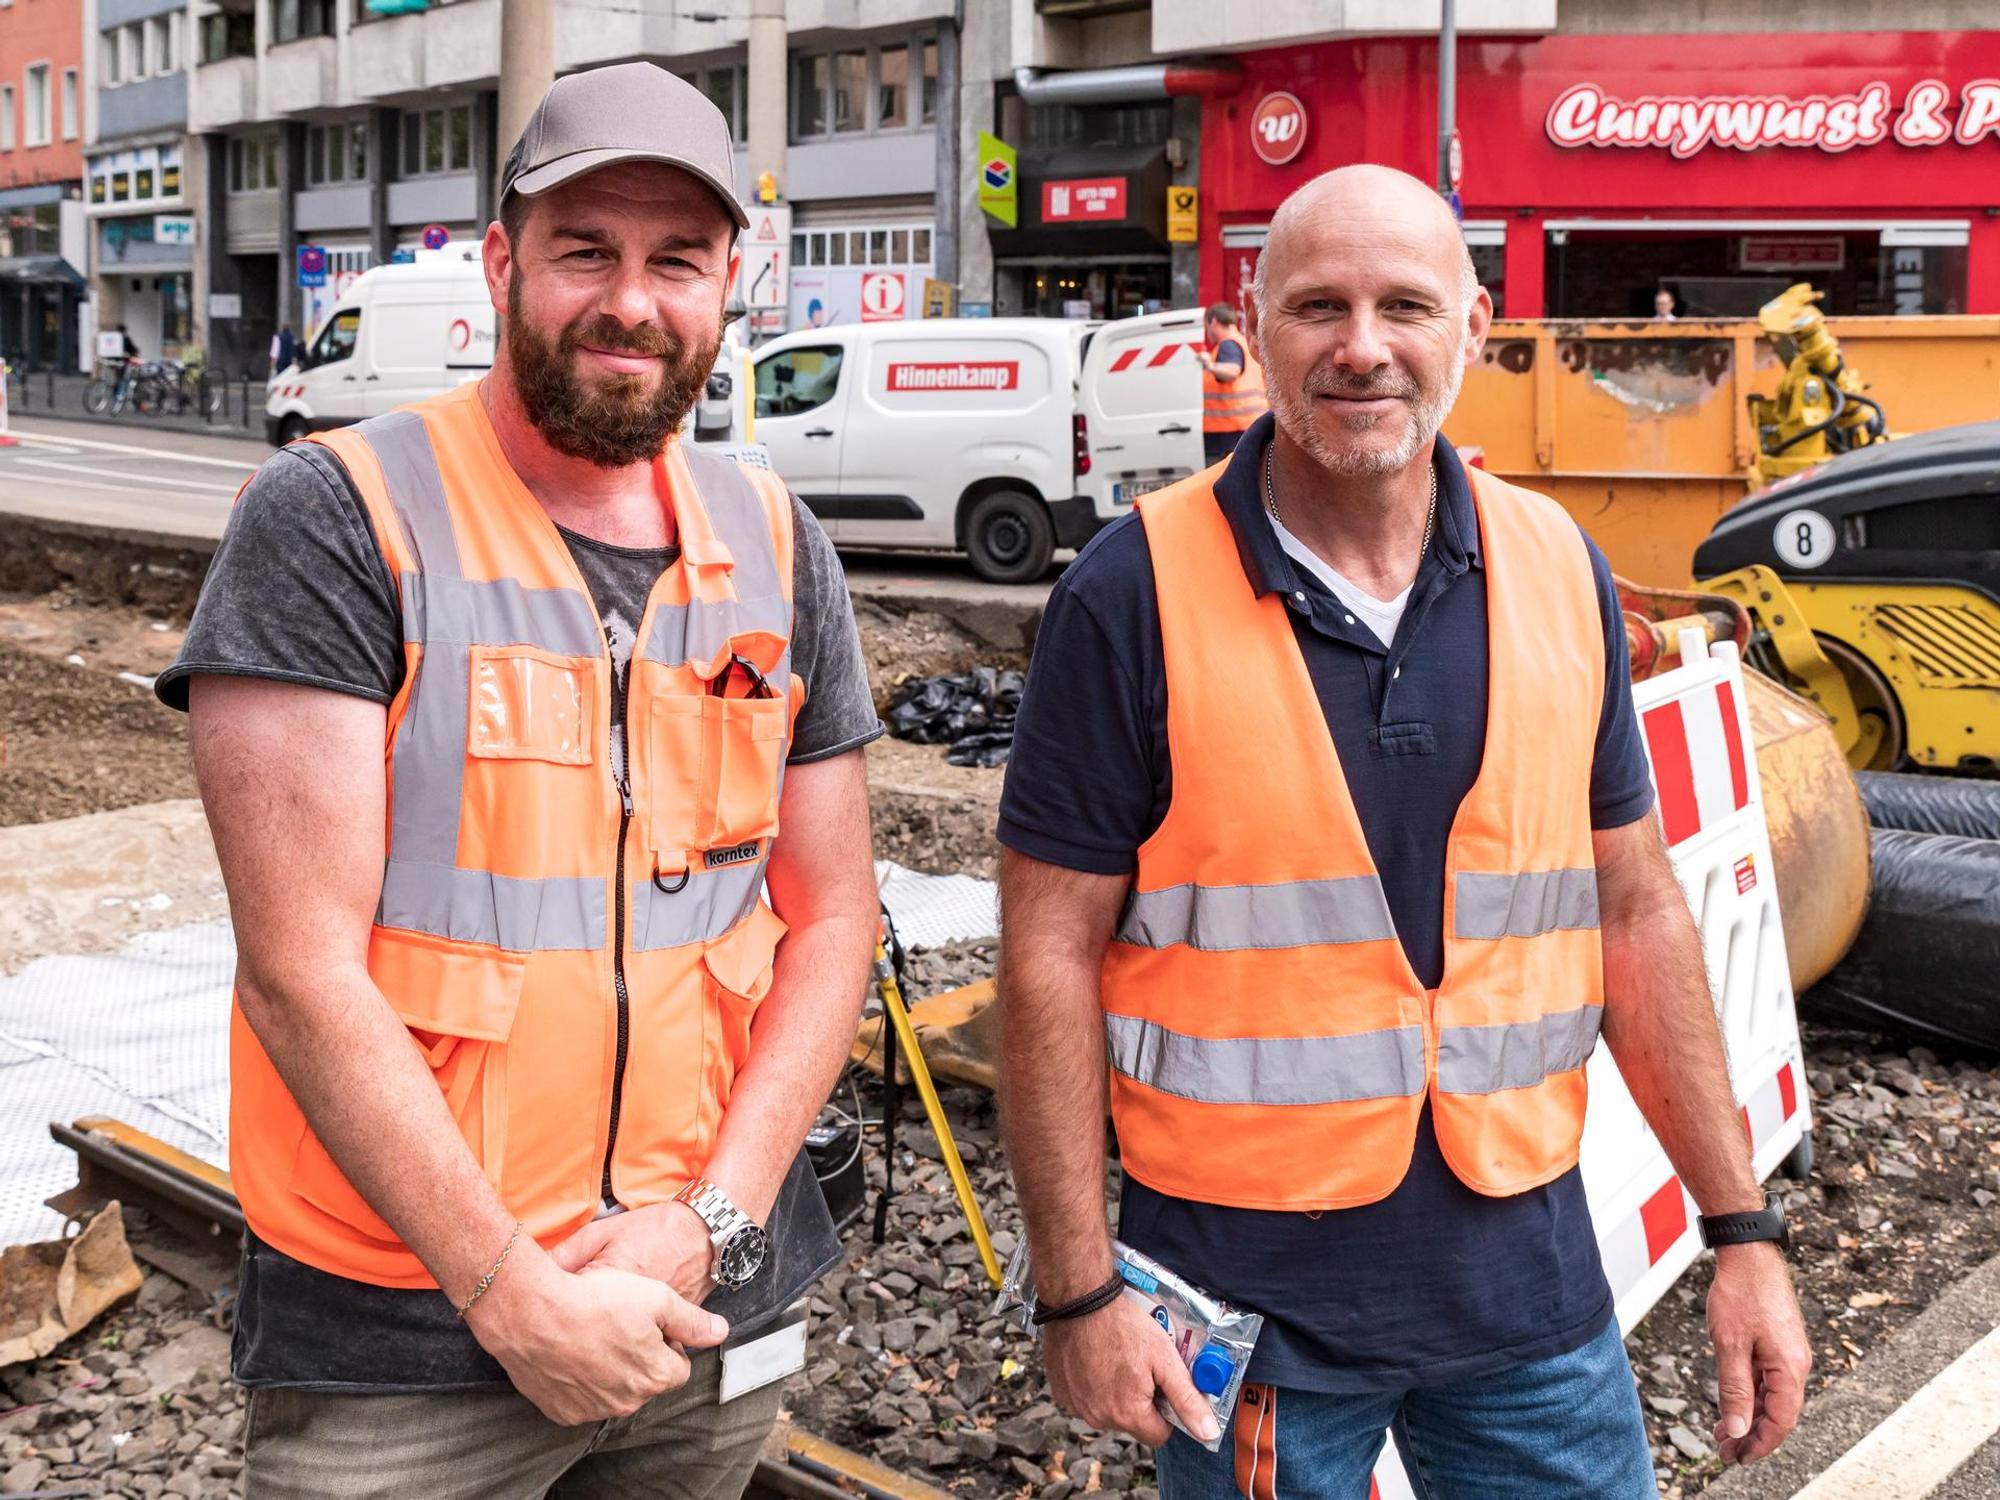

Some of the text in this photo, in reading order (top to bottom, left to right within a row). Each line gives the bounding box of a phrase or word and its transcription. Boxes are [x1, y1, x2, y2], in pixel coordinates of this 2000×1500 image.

[1548, 84, 1888, 157] Currywurst
[1897, 82, 1950, 142] &
[895, 364, 1010, 390] Hinnenkamp
[1797, 522, 1812, 556] 8
[709, 845, 758, 866] korntex
